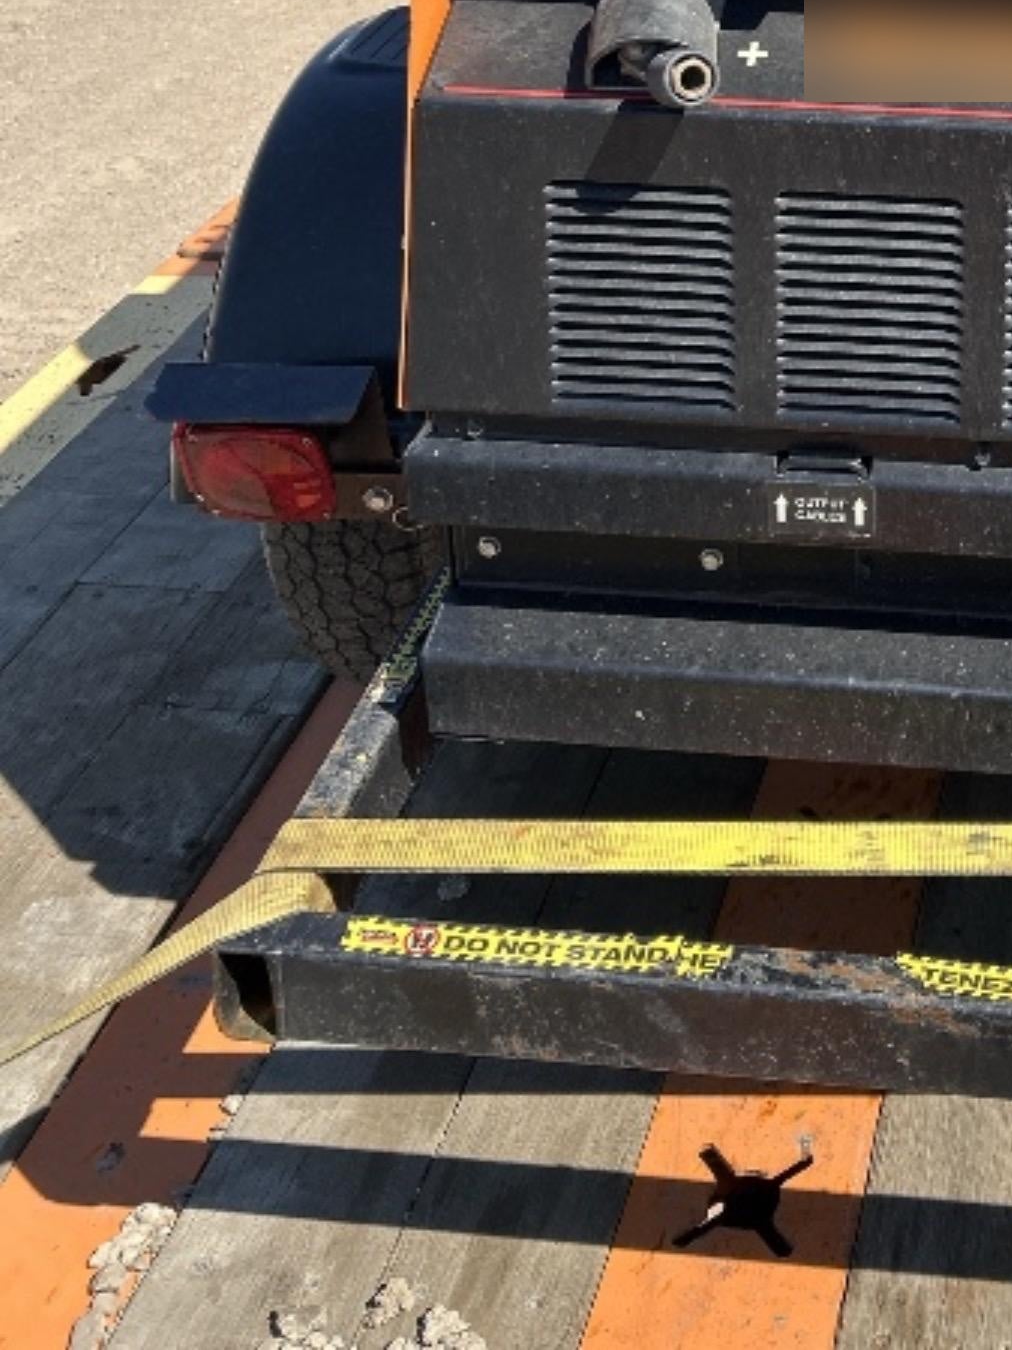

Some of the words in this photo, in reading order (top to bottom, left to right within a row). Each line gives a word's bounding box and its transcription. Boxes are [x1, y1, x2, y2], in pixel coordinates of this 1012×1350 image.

[443, 935, 490, 952] DO
[495, 938, 560, 957] NOT
[566, 944, 669, 964] STAND
